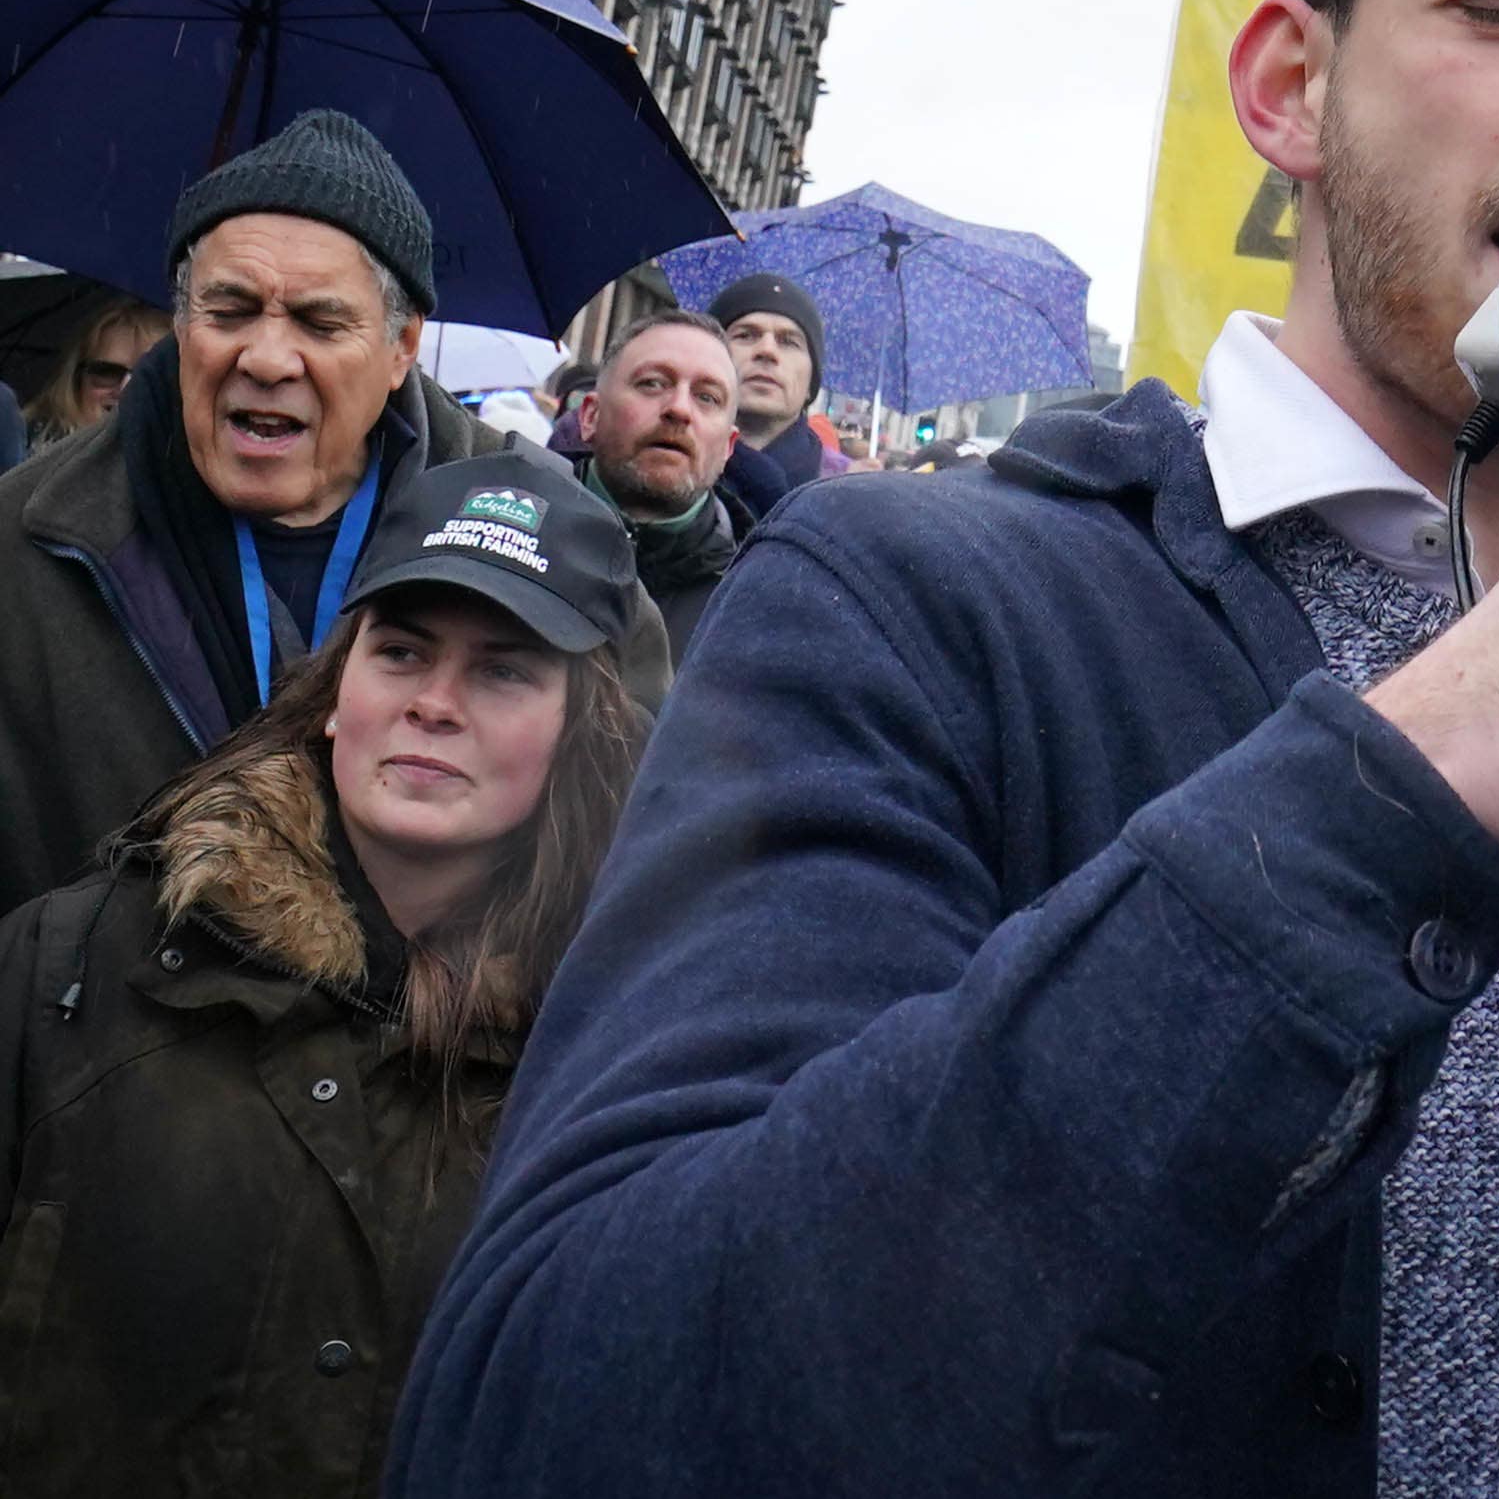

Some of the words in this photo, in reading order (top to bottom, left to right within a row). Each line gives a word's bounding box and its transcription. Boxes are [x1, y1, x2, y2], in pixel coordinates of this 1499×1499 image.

[422, 532, 479, 548] BRITISH
[480, 536, 550, 574] FARMING
[443, 519, 539, 551] SUPPORTING
